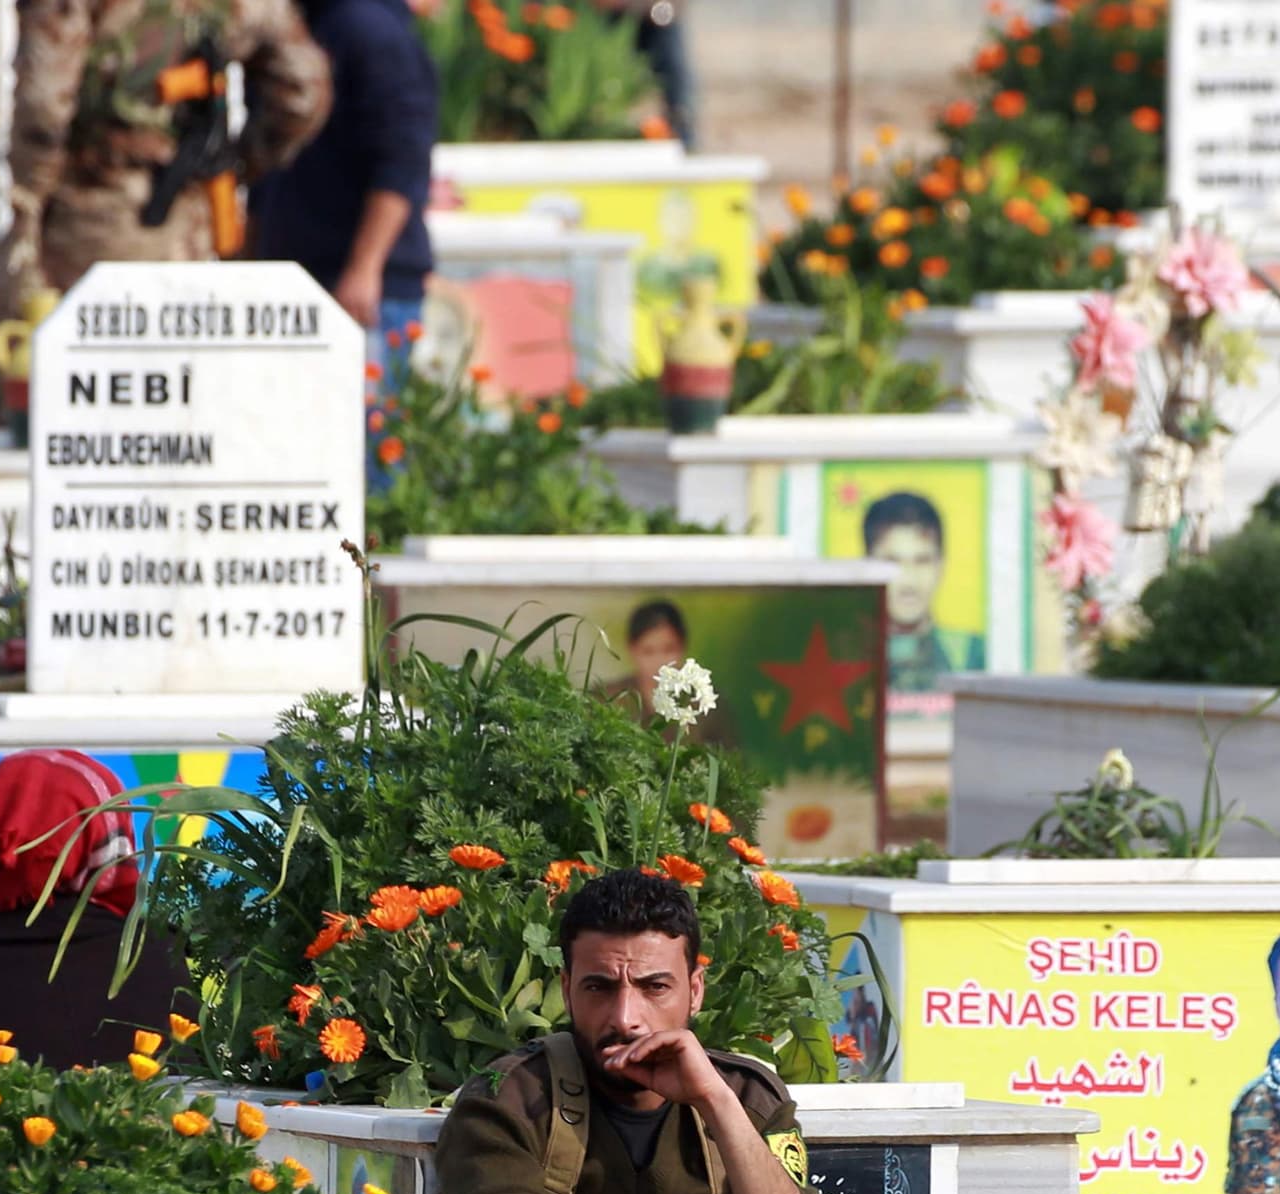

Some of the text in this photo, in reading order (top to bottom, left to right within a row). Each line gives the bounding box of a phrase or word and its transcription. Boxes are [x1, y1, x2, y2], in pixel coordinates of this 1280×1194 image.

[47, 433, 213, 466] EBDULREHMAN
[196, 502, 340, 536] ŞERNEX
[51, 557, 88, 586] CIH
[52, 610, 346, 638] MUNBIC 11-7-2017
[1029, 932, 1160, 979] ŞEHÎD
[926, 983, 1237, 1038] RÊNAS KELEŞ
[1013, 1053, 1161, 1105] الشهيد
